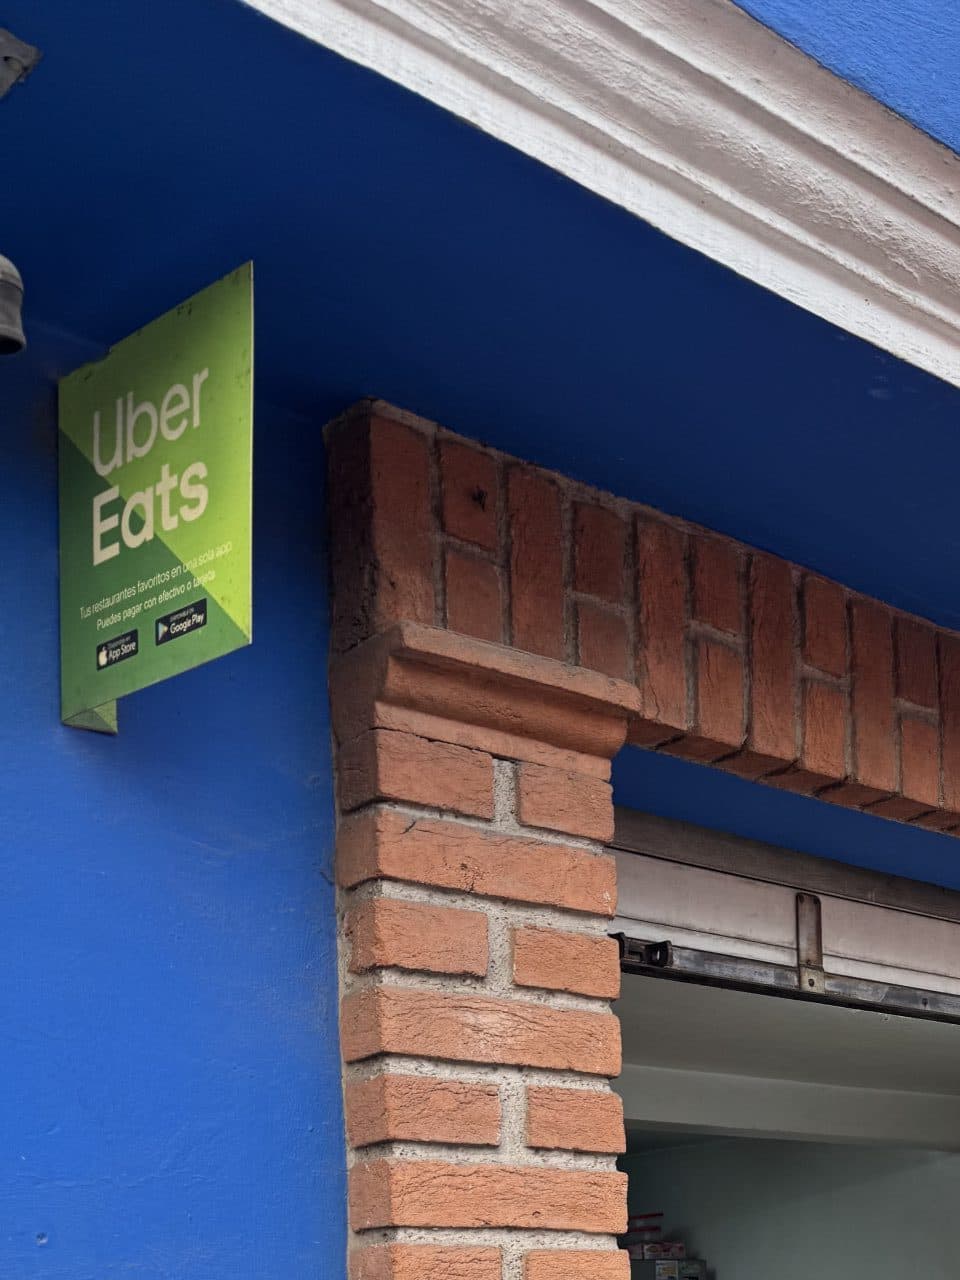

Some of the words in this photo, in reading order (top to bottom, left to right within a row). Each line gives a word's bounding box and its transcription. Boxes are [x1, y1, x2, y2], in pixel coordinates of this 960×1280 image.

[92, 367, 209, 477] Uber
[92, 461, 209, 567] Eats
[92, 586, 136, 614] restaurantes
[137, 569, 170, 593] favoritos
[171, 565, 182, 578] en
[97, 611, 121, 631] Puedes
[122, 601, 143, 619] pagar
[143, 597, 157, 610] con
[158, 584, 185, 604] efectivo
[170, 617, 192, 635] Google
[191, 612, 204, 626] Play
[108, 646, 122, 661] App
[121, 641, 136, 657] Store
